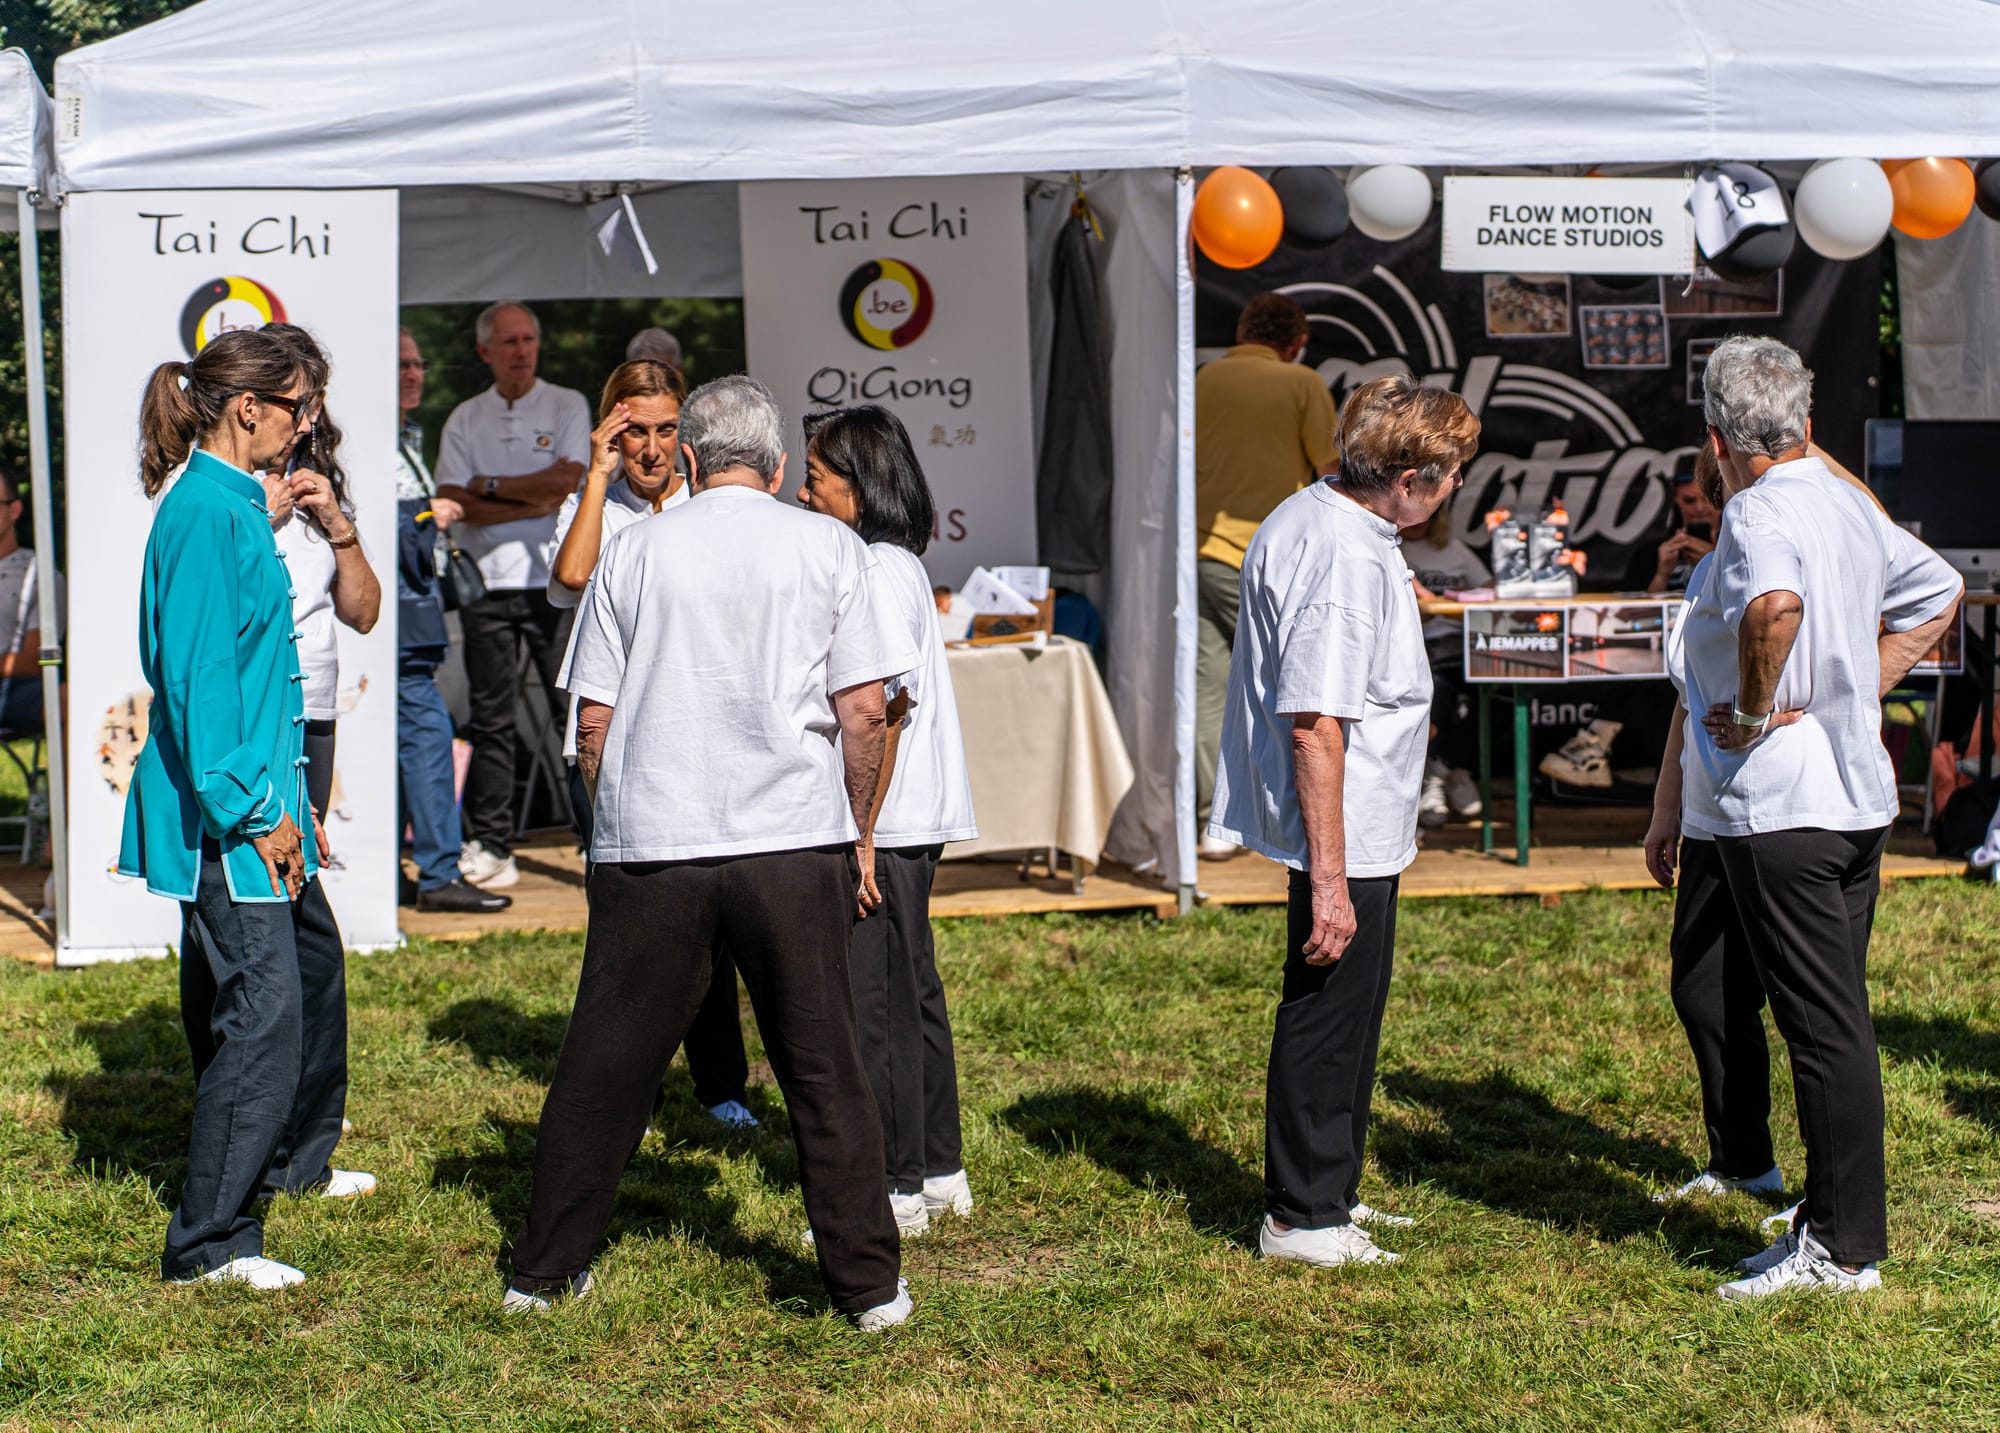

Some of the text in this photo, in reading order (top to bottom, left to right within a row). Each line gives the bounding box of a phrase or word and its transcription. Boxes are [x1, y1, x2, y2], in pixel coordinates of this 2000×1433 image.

[1489, 205, 1652, 224] FLOW MOTION
[1715, 181, 1756, 221] 18
[137, 212, 331, 259] Tai Chi
[798, 201, 968, 244] Tai Chi
[1477, 228, 1664, 247] DANCE STUDIOS
[807, 366, 973, 409] QiGong
[927, 423, 978, 448] 氣功
[1489, 636, 1558, 651] JEMAPPES
